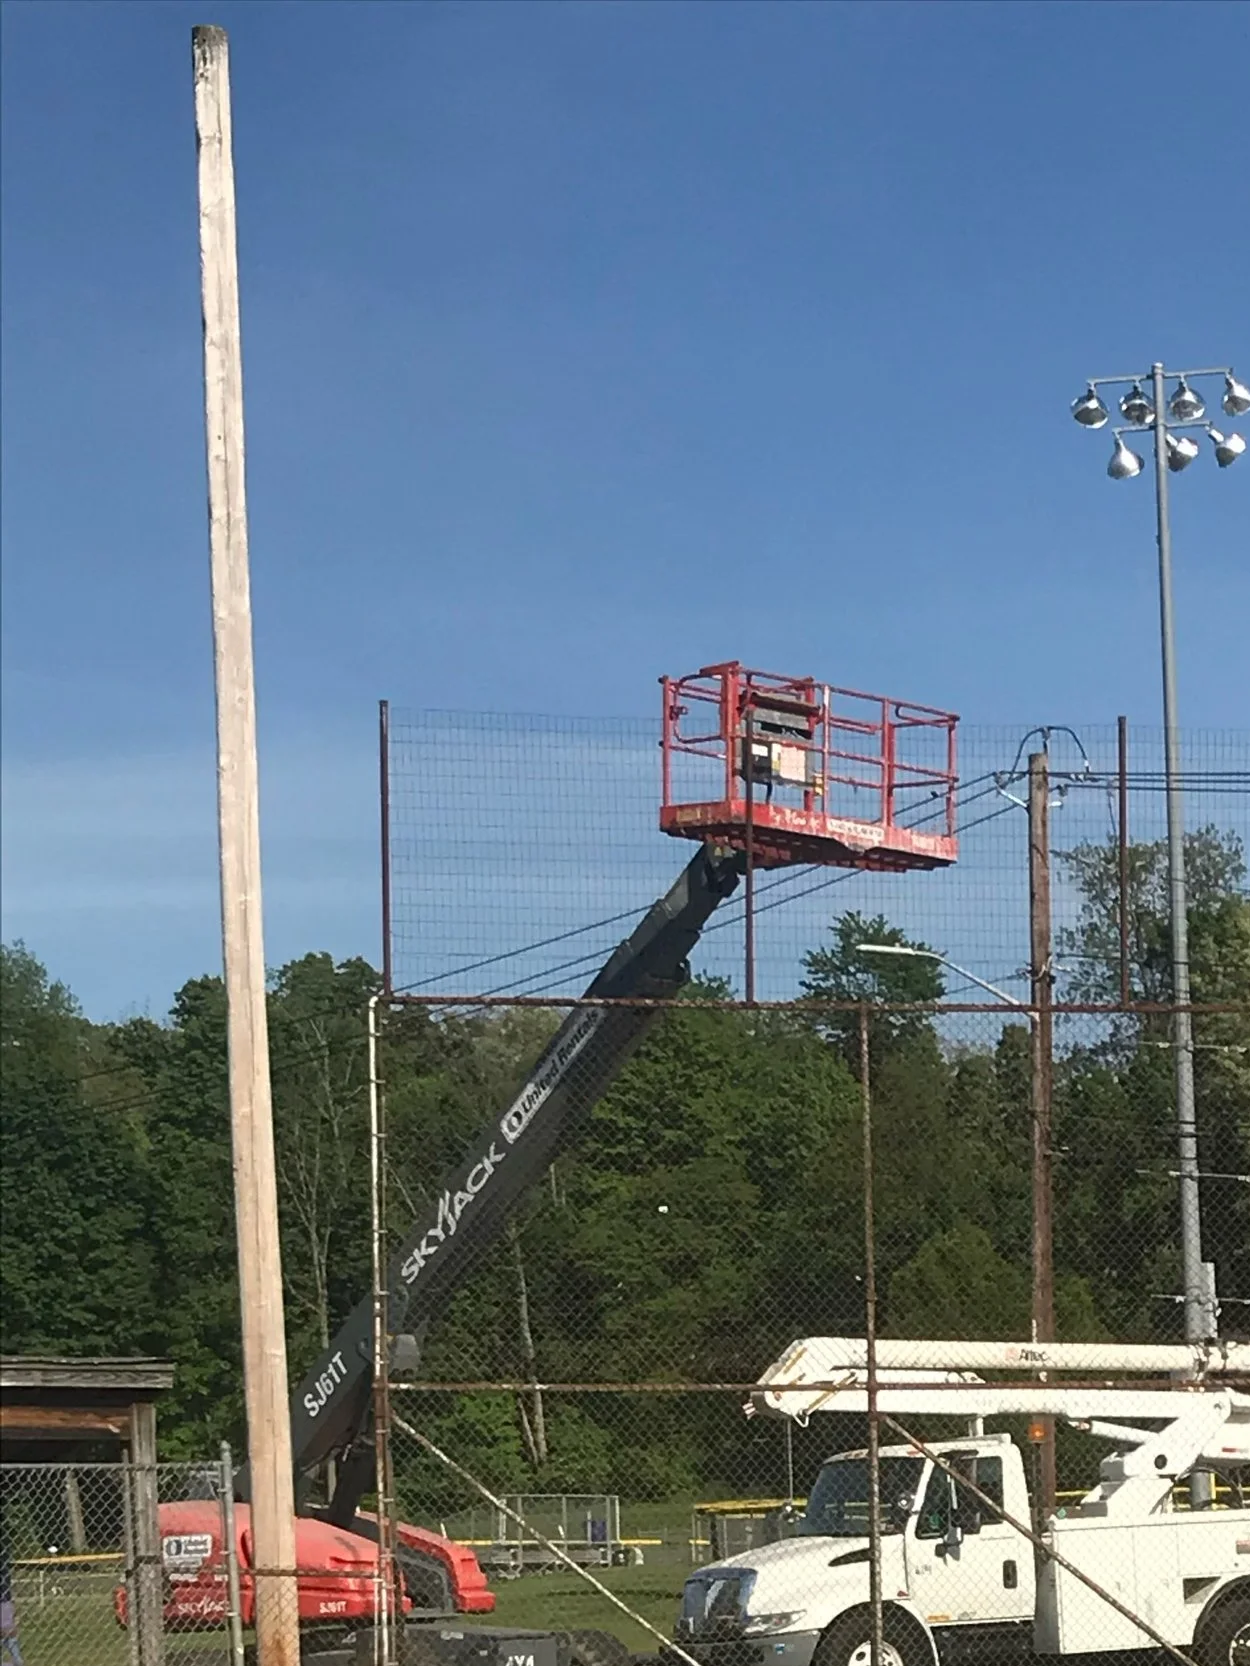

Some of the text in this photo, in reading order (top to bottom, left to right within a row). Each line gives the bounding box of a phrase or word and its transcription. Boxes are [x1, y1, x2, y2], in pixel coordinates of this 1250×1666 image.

[521, 1060, 559, 1113] United
[401, 1142, 506, 1284] SKYJACK
[304, 1351, 348, 1417] SJ61T
